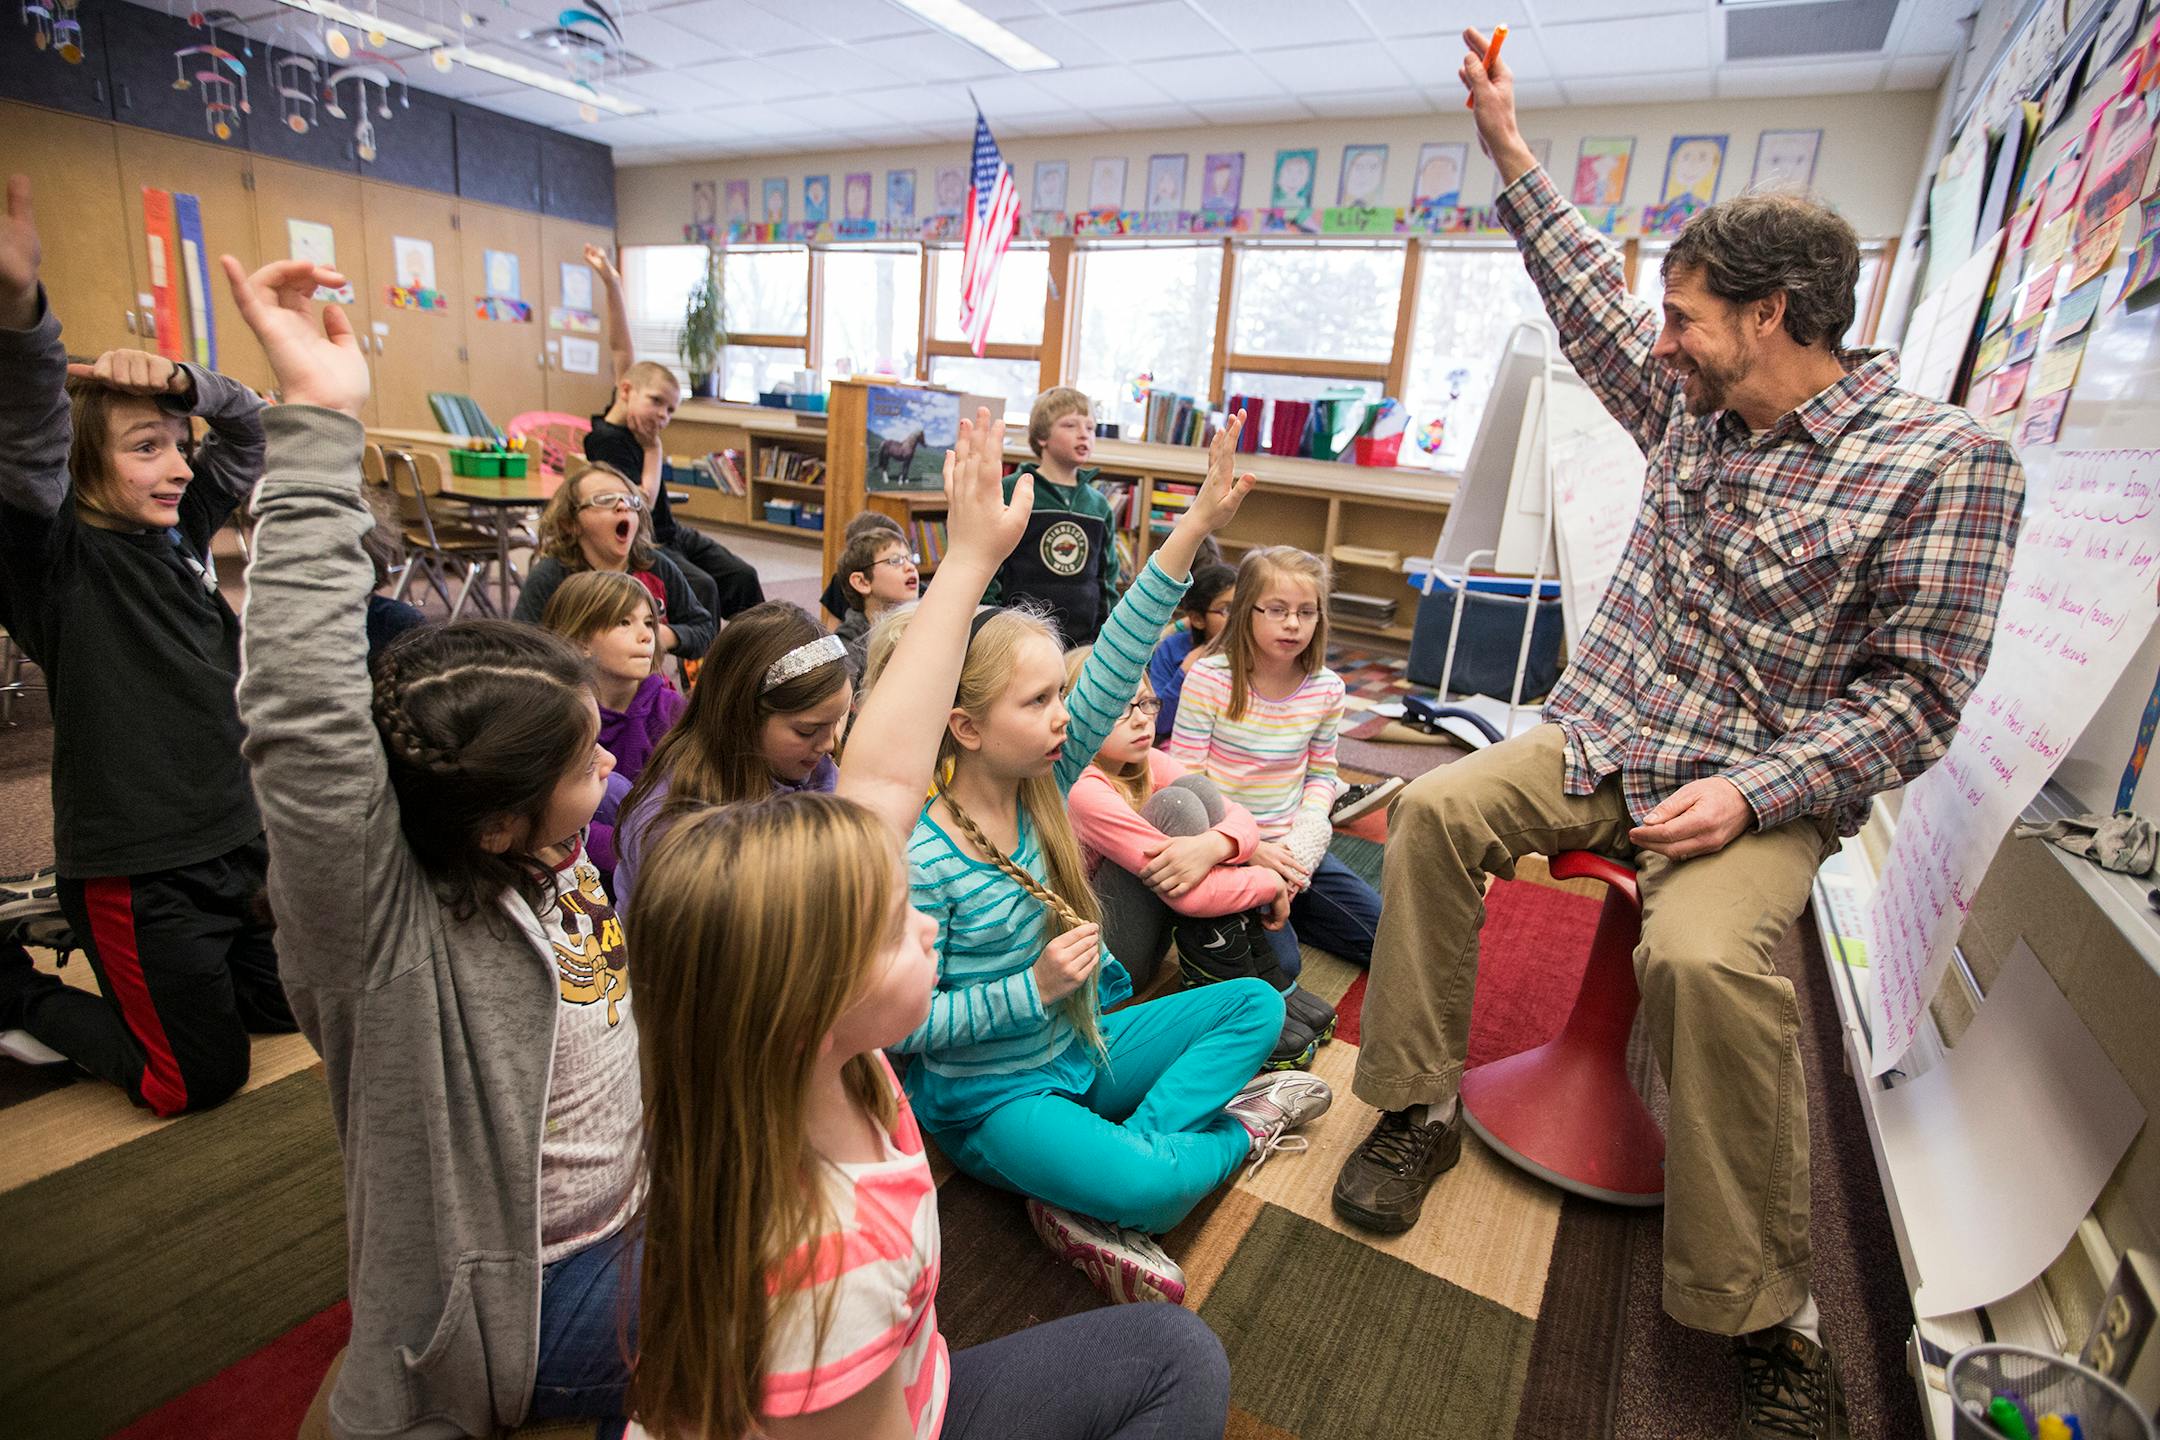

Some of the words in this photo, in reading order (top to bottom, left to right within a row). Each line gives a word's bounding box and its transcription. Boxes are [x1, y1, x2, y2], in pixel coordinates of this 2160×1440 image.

[1045, 525, 1085, 547] MINNESOTA
[1053, 560, 1076, 572] WILD
[601, 916, 624, 952] M
